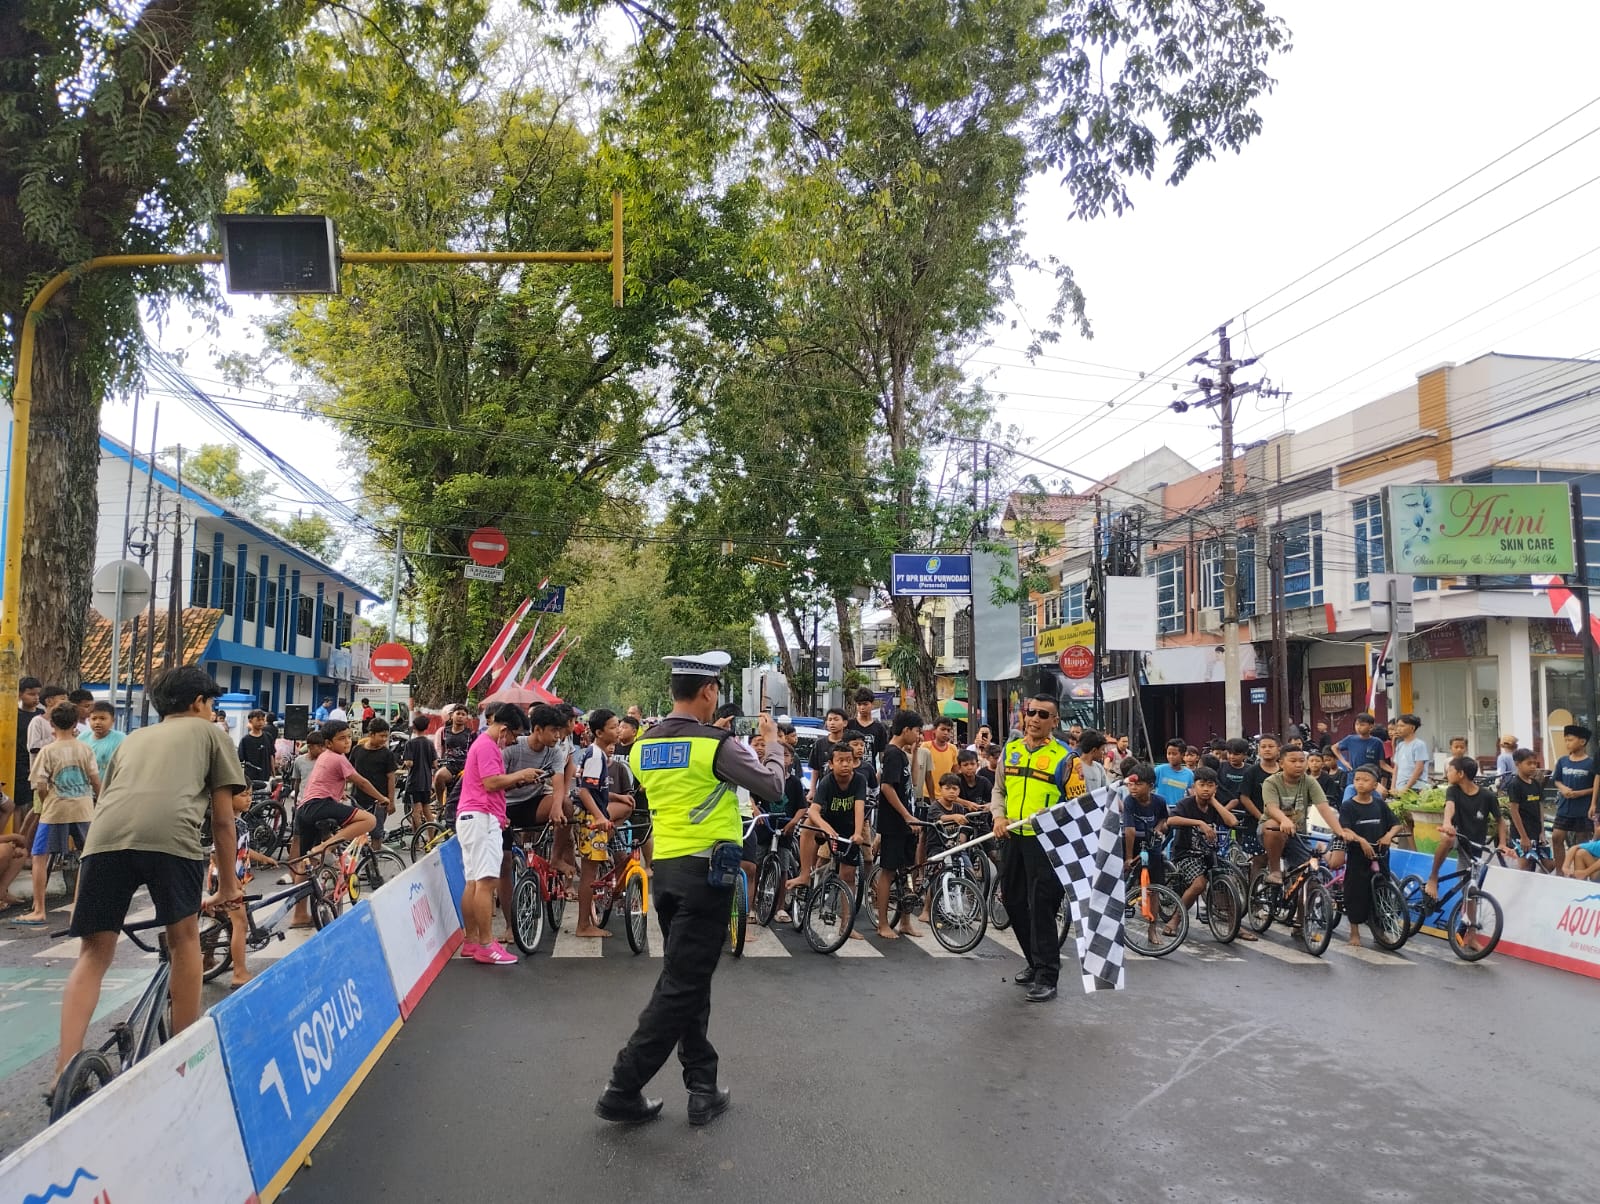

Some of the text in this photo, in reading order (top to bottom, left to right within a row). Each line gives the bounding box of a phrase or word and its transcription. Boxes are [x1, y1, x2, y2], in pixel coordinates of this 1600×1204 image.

[1440, 489, 1546, 537] Arini
[1500, 538, 1554, 551] SKIN CARE
[1413, 555, 1434, 565] Skin
[1437, 554, 1467, 567] Beauty
[1484, 554, 1517, 568] Healthy
[1519, 554, 1540, 565] With
[1064, 657, 1089, 667] Happy
[816, 667, 829, 676] SU
[642, 745, 687, 766] POLISI
[293, 978, 362, 1095] ISOPLUS
